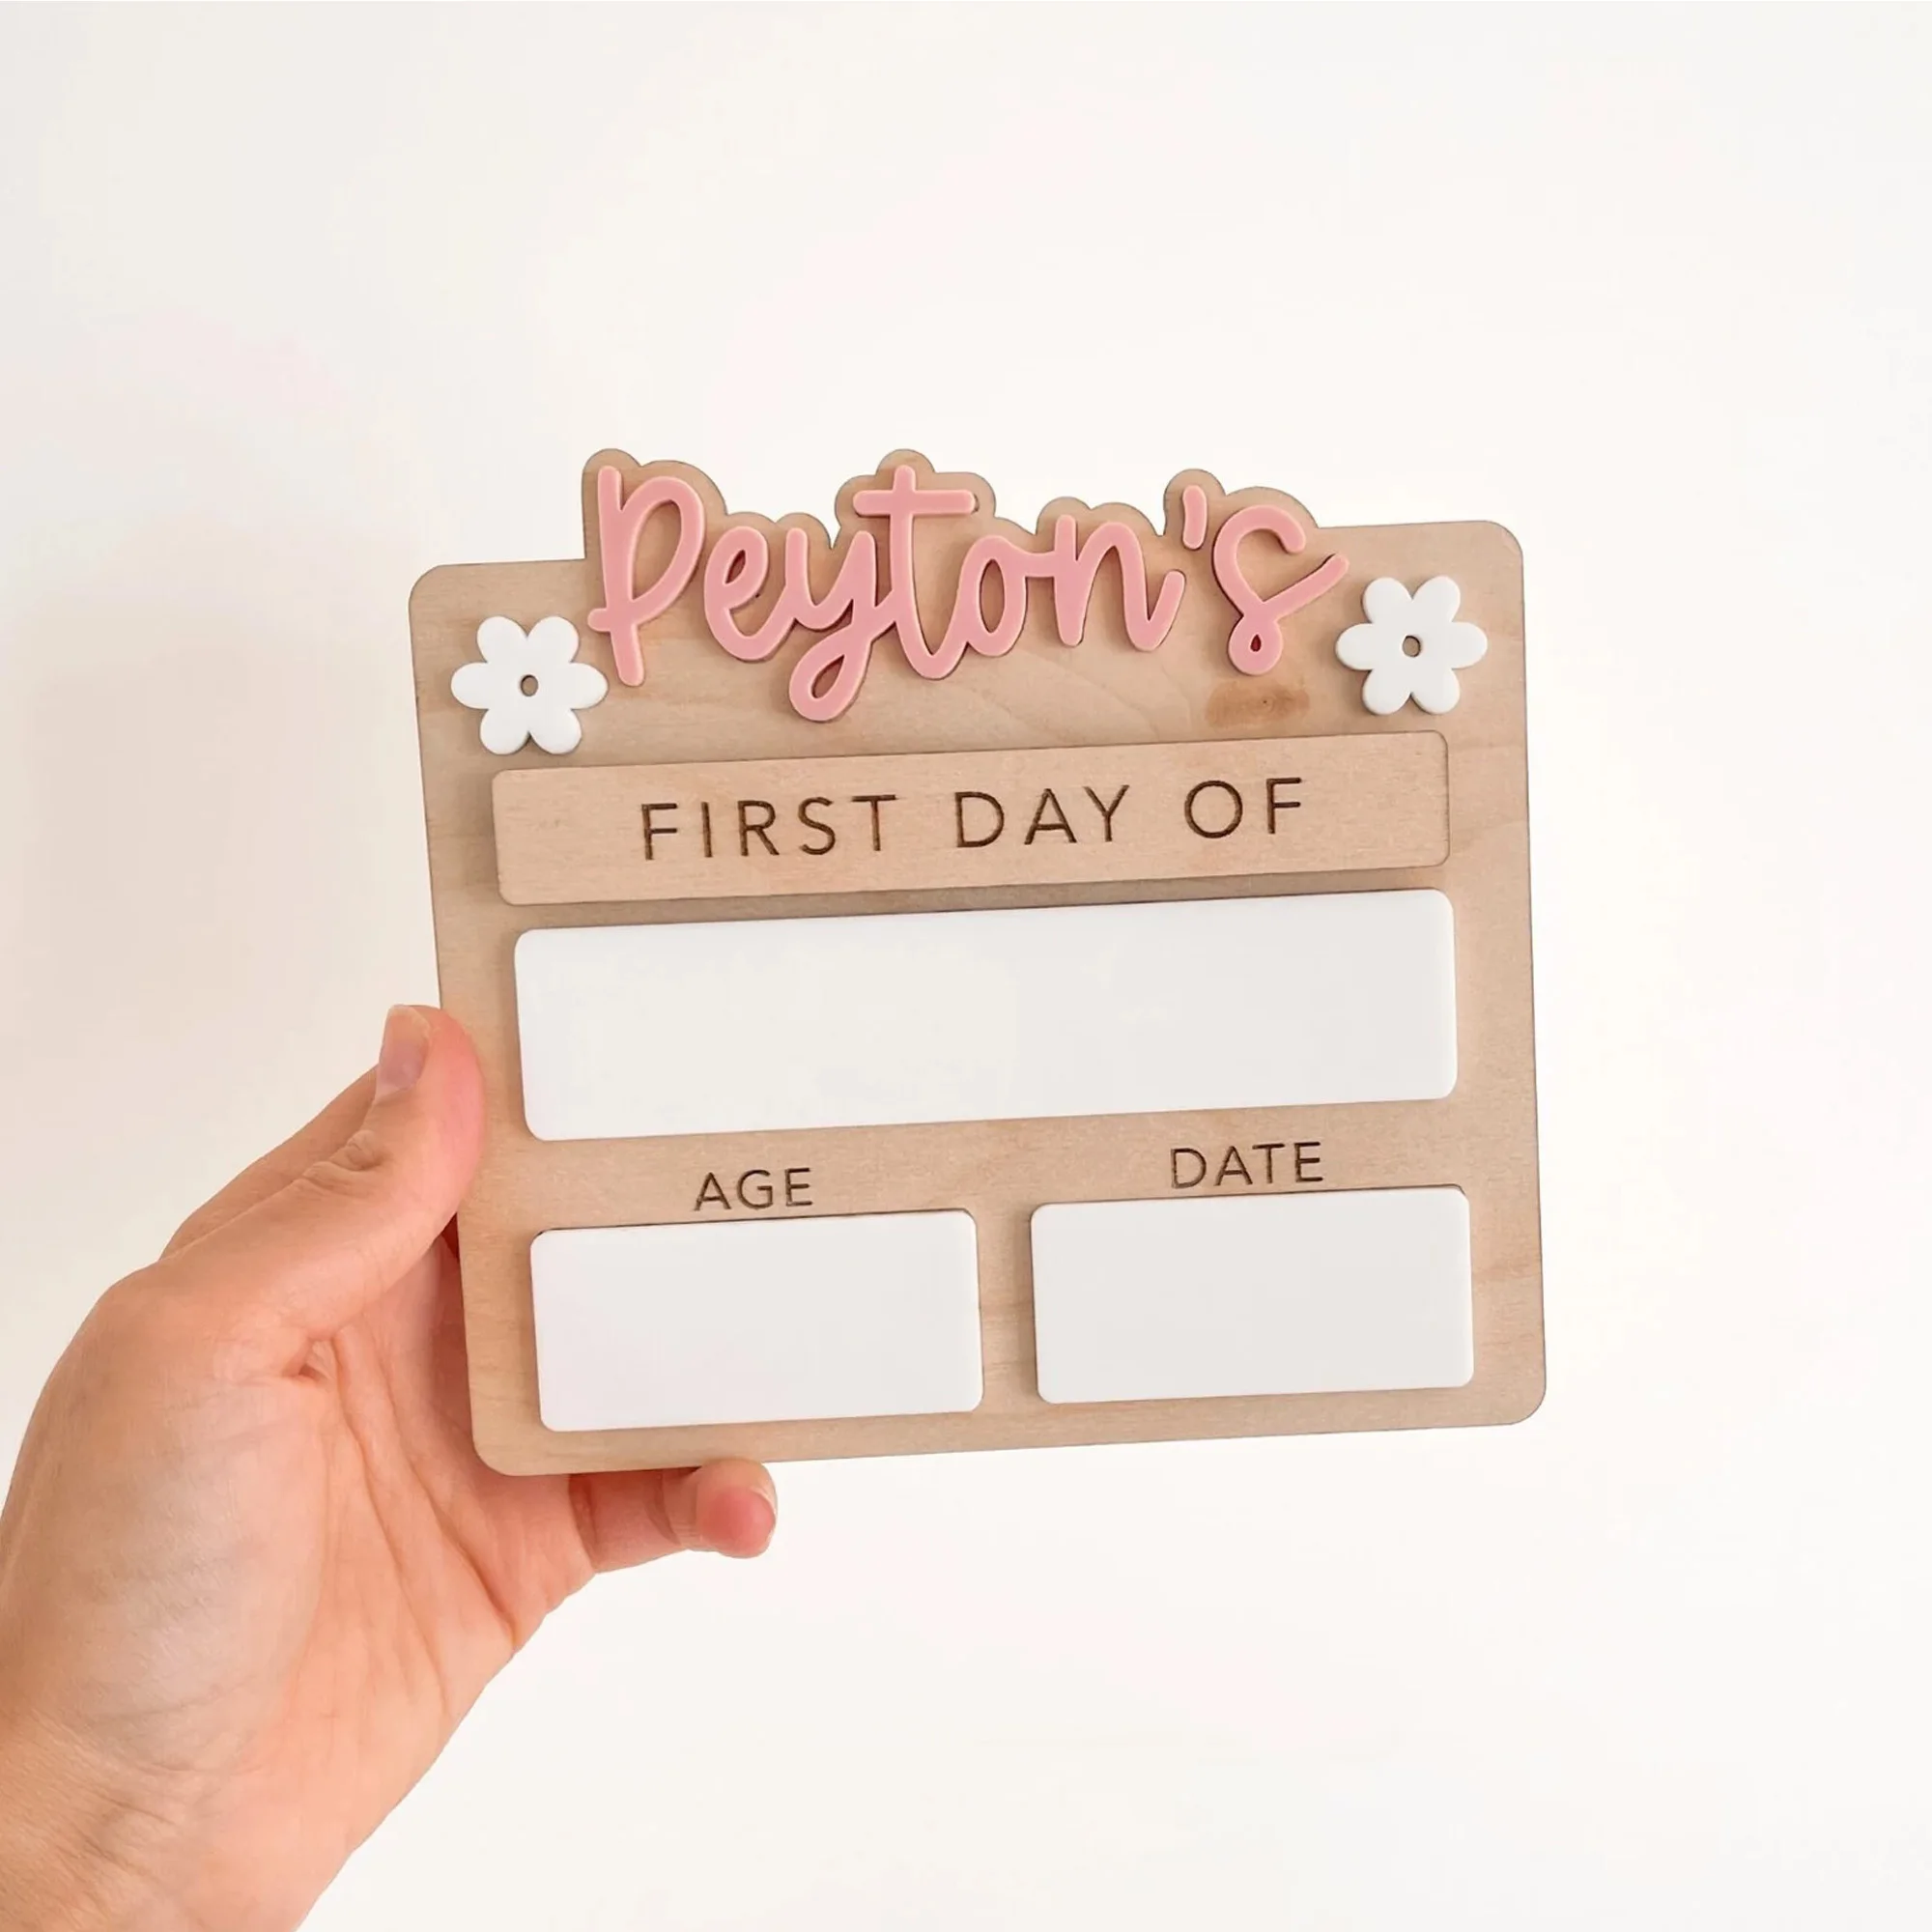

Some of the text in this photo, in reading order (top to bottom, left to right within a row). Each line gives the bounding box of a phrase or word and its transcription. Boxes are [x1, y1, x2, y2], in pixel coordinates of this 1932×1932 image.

[587, 464, 1350, 723] Peyton's
[640, 777, 1304, 861] FIRST DAY OF
[694, 1166, 814, 1211] AGE
[1170, 1141, 1324, 1189] DATE
